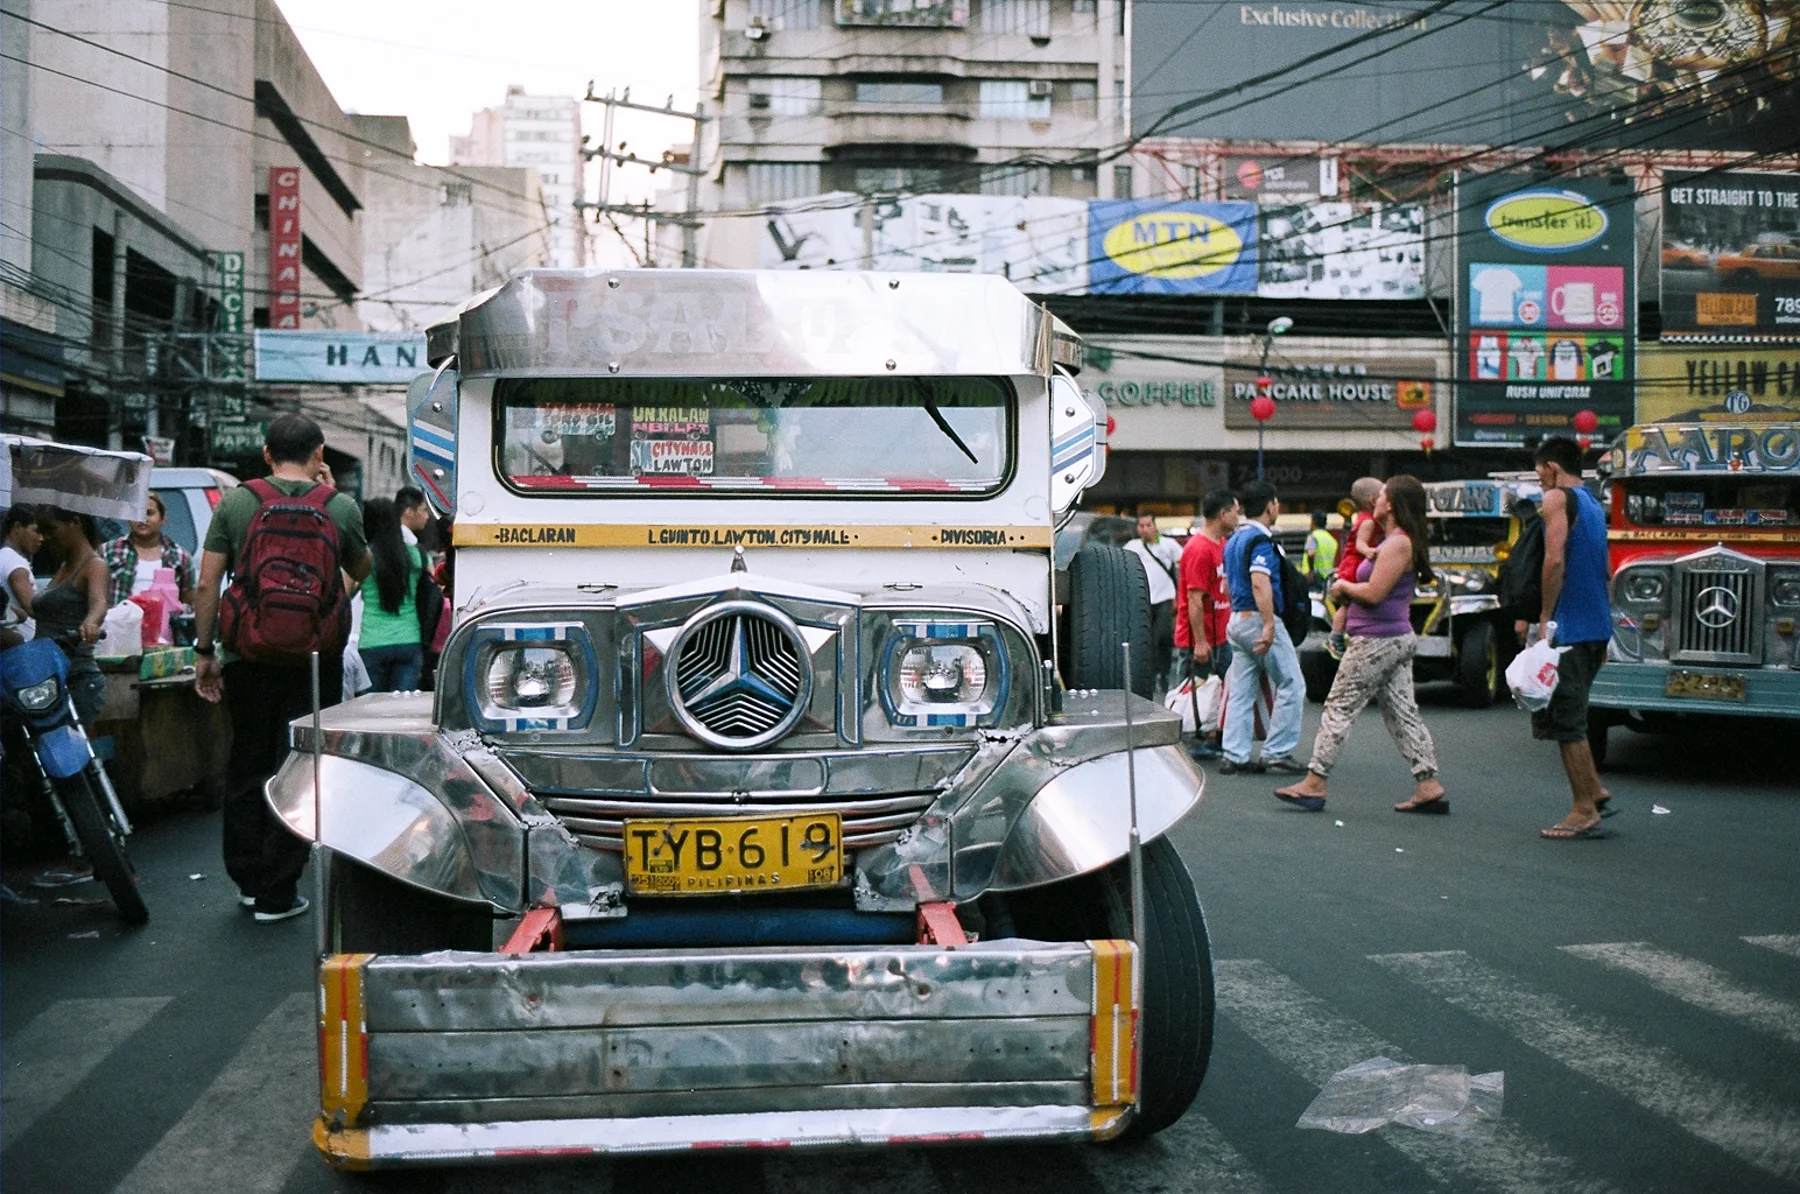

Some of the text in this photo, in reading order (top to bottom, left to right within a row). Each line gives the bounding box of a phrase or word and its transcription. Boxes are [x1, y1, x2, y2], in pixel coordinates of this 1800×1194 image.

[1240, 6, 1428, 31] Exclusive Collectin
[1671, 188, 1799, 208] GET STRAIGHT TO THE
[1134, 221, 1209, 245] MTN
[327, 344, 417, 368] HAN
[1686, 360, 1768, 395] YELLOW
[1098, 380, 1217, 407] COFFEE
[1328, 384, 1392, 401] HOUSE
[1506, 385, 1591, 399] RUSH UNIFORM
[653, 458, 712, 473] LAWTON
[499, 528, 576, 543] BACLARAN
[940, 528, 1006, 545] DIVISORIA
[687, 871, 781, 887] PILIPINAS
